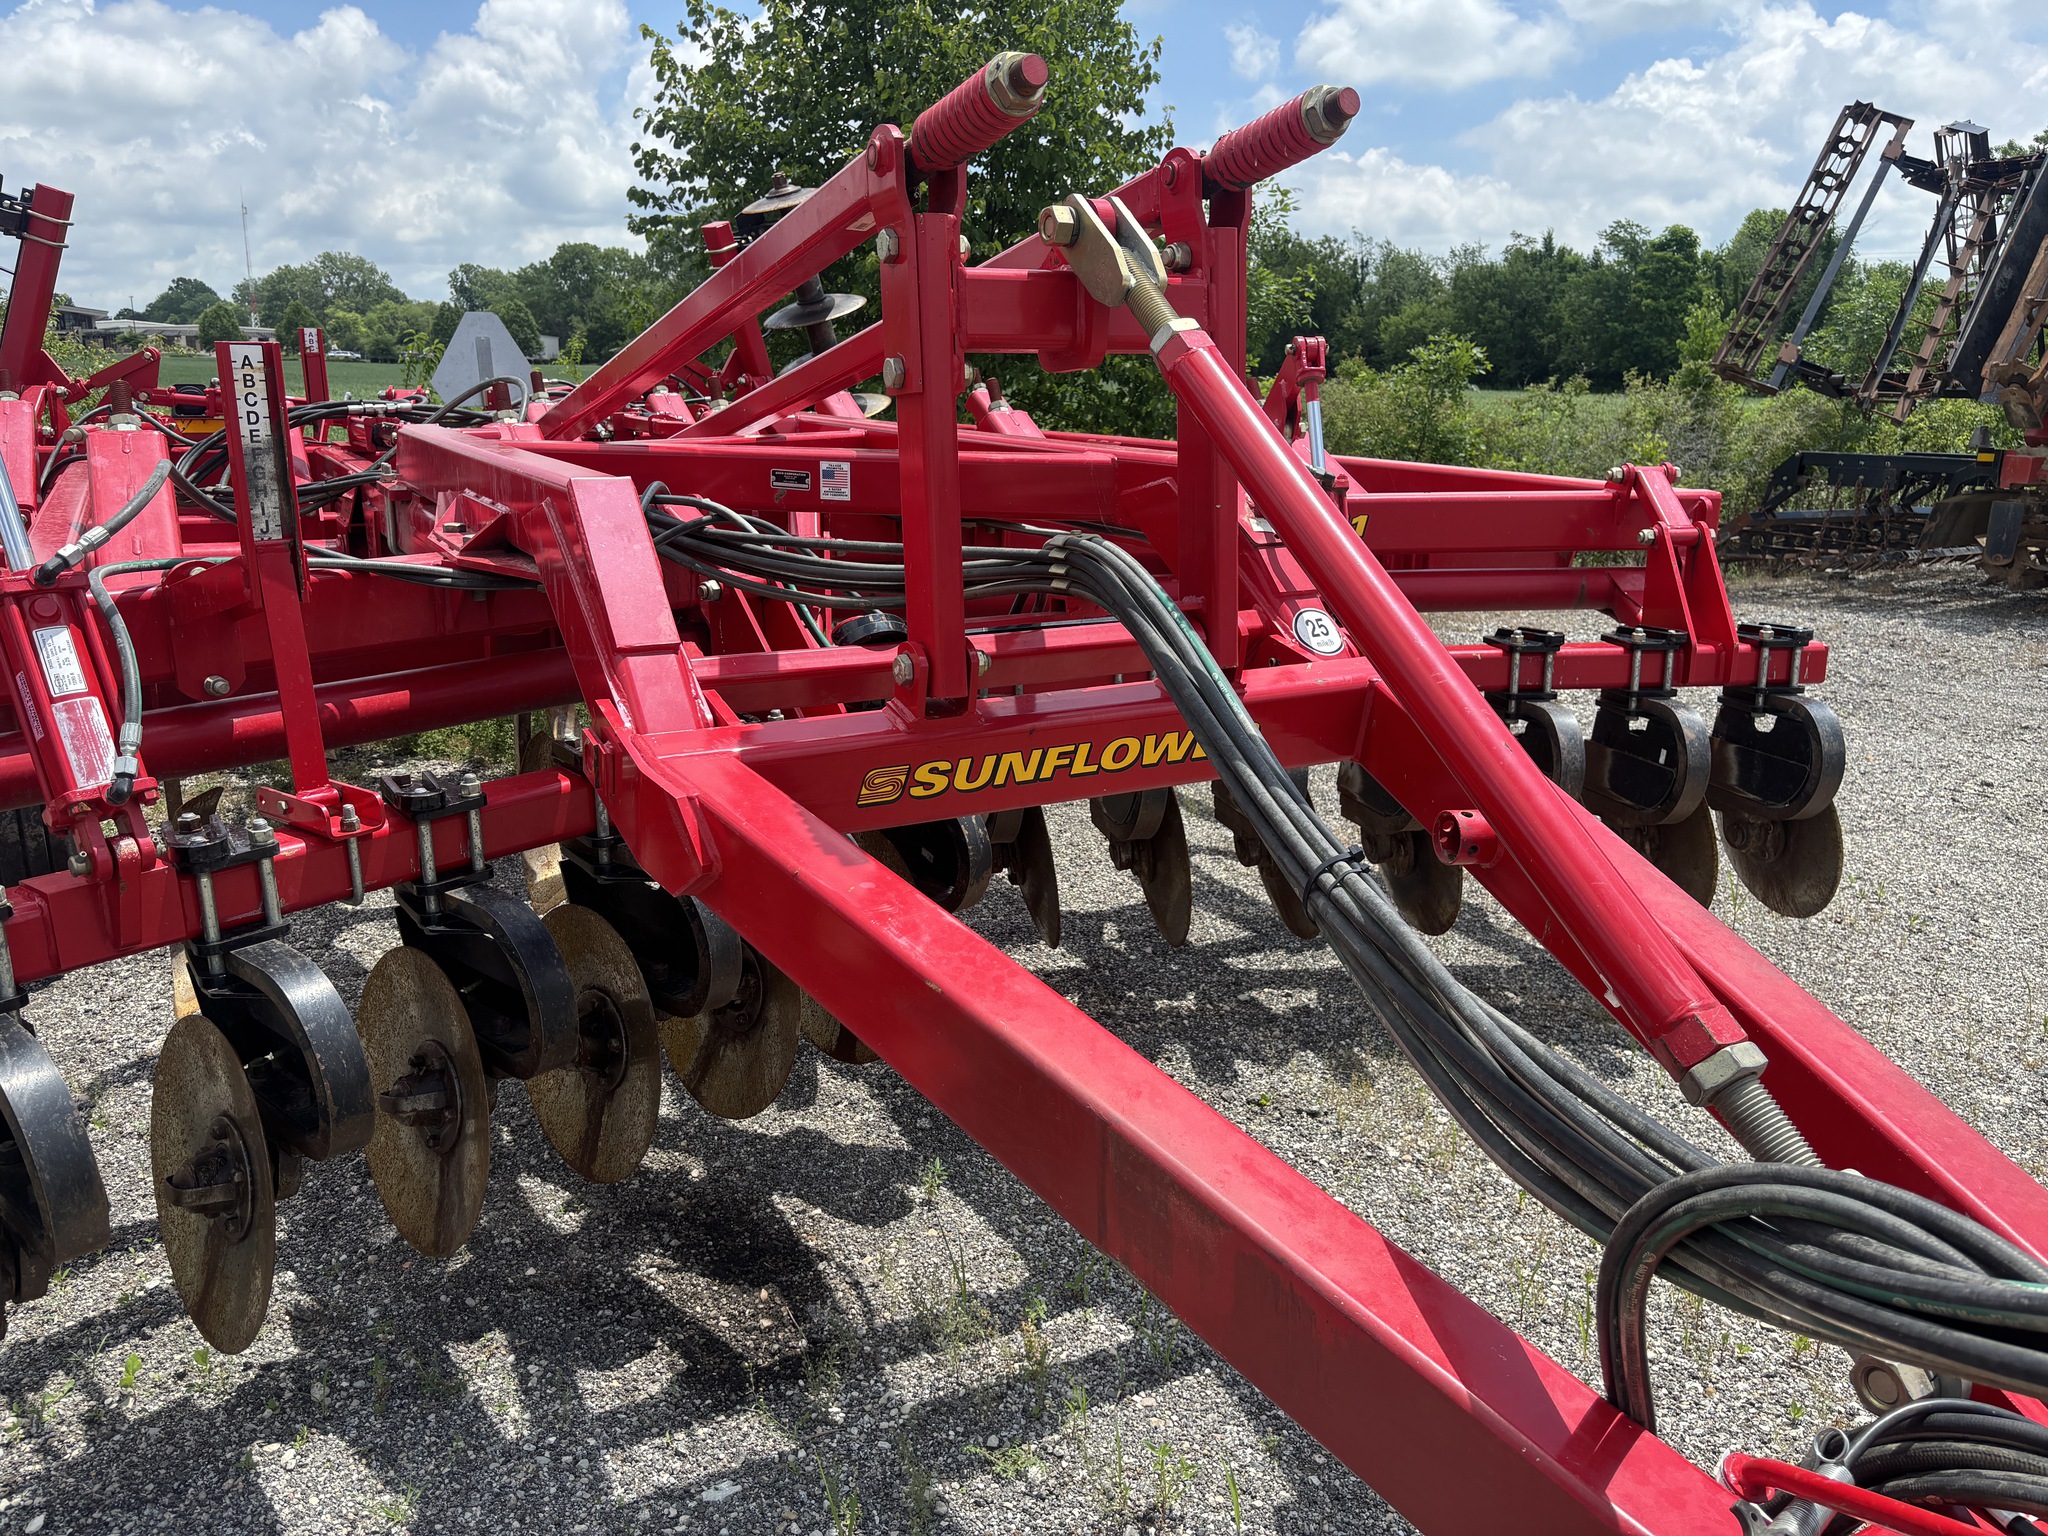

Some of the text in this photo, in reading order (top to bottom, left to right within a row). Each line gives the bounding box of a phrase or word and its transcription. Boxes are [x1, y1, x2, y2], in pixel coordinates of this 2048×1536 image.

[241, 354, 254, 369] A
[243, 374, 255, 388] B
[244, 392, 258, 407] C
[246, 411, 259, 425] D
[250, 429, 261, 443] E
[252, 448, 262, 462] F
[252, 465, 265, 479] G
[255, 484, 267, 498] H
[261, 502, 265, 516] I
[260, 520, 269, 534] J
[1305, 618, 1329, 638] 25
[908, 727, 1214, 798] SUNFLOW
